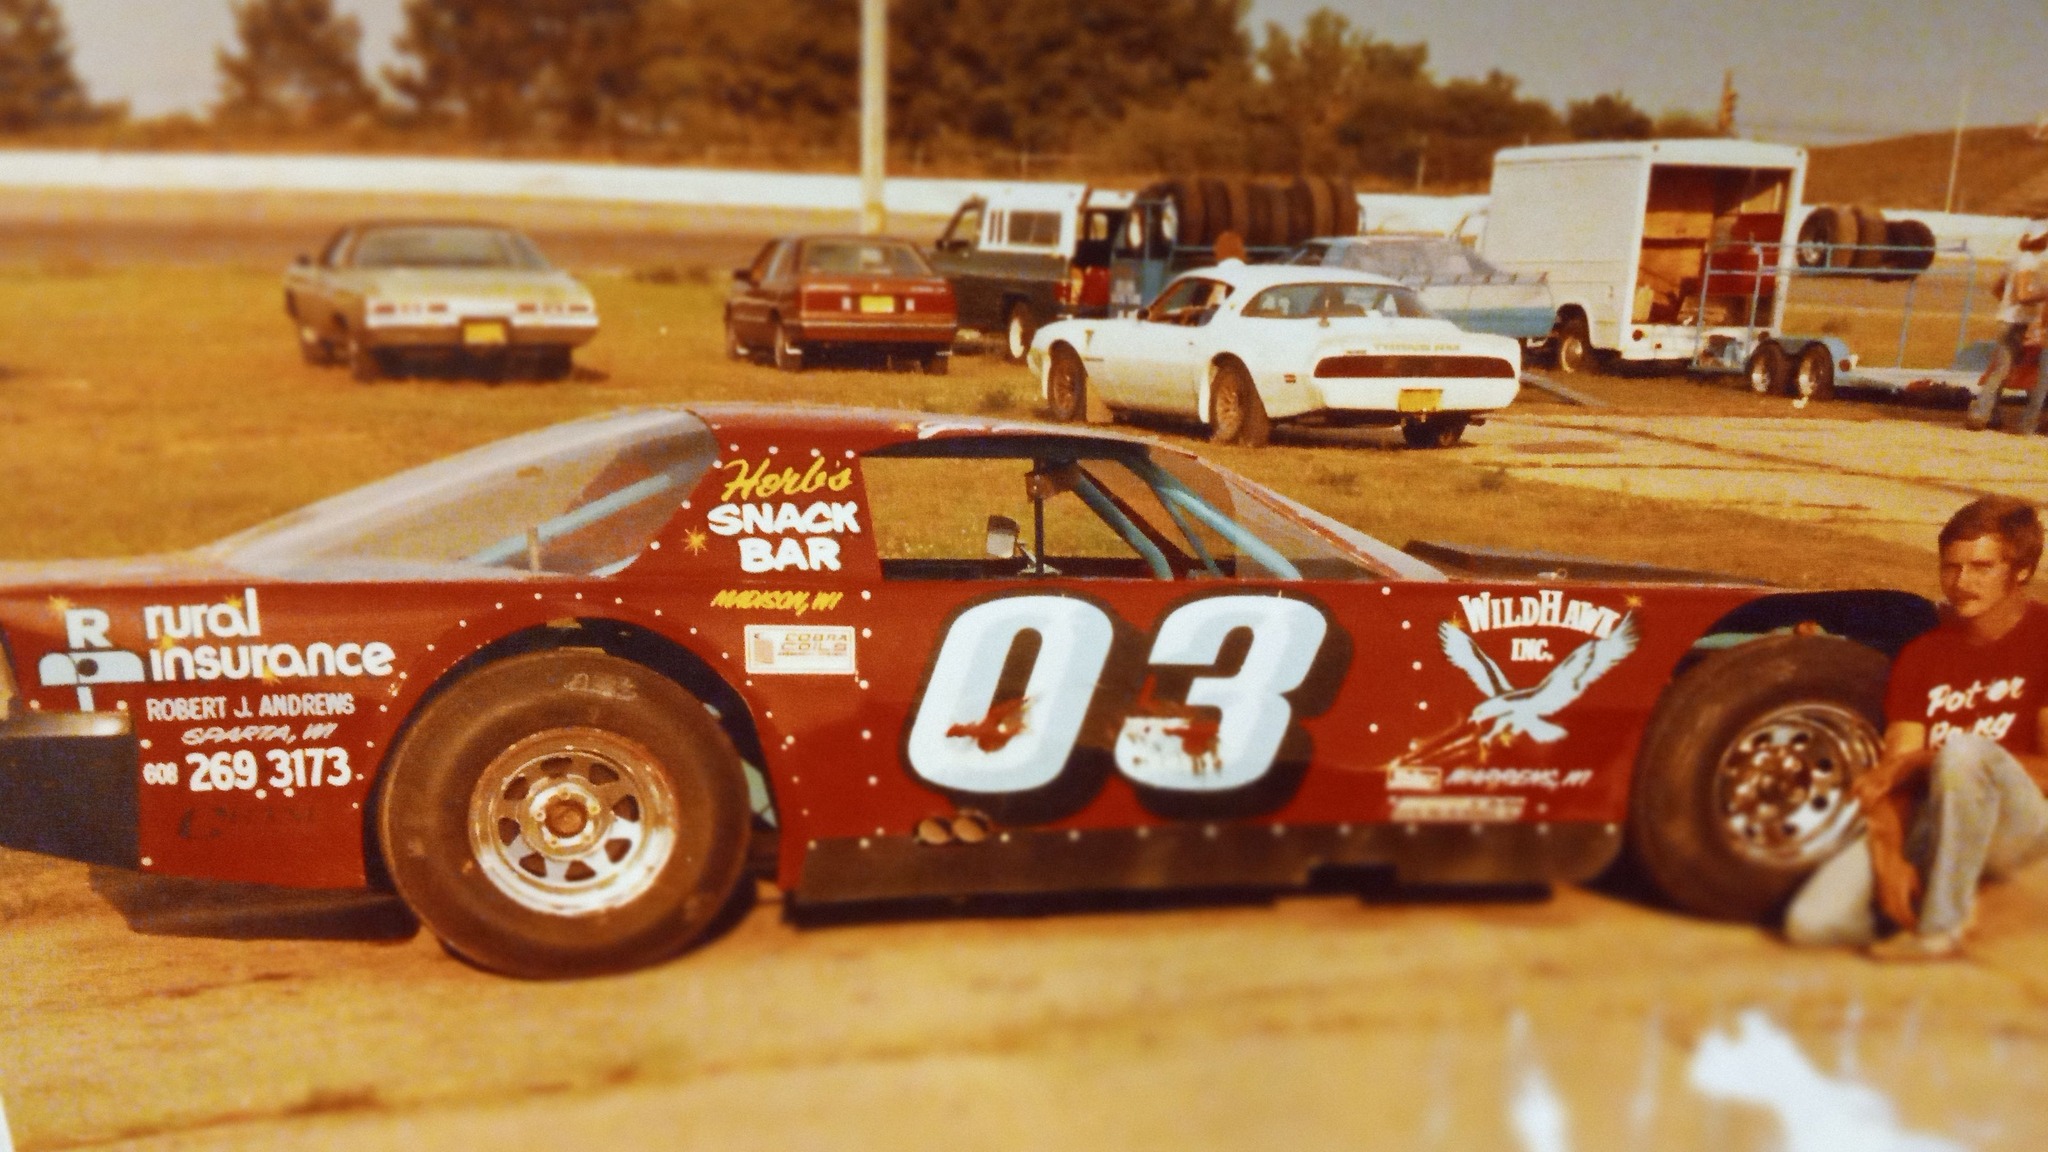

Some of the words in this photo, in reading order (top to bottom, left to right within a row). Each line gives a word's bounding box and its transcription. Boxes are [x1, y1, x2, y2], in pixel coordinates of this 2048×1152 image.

[707, 500, 862, 536] SNACK
[737, 537, 842, 574] BAR
[65, 608, 113, 649] R
[143, 587, 261, 639] rural
[149, 641, 397, 682] insurance
[1511, 637, 1554, 662] INC.
[146, 696, 228, 722] ROBERT
[233, 696, 254, 719] J.
[259, 693, 356, 717] ANDREWS
[907, 594, 1328, 794] 03
[143, 762, 179, 786] 608
[185, 749, 258, 792] 269
[265, 746, 352, 788] 3173
